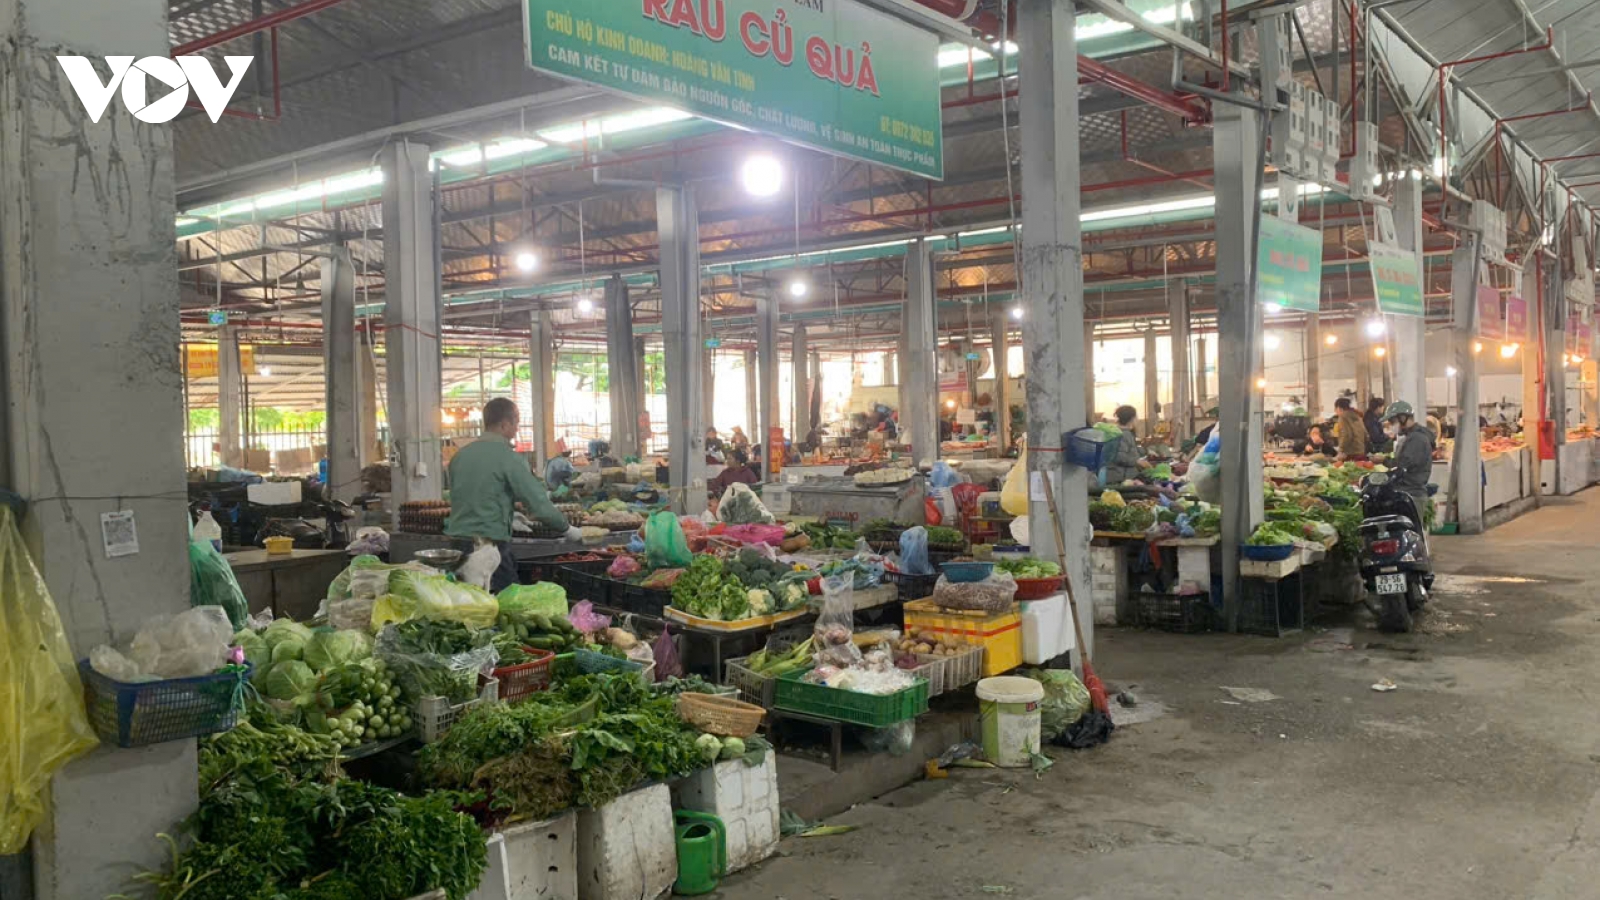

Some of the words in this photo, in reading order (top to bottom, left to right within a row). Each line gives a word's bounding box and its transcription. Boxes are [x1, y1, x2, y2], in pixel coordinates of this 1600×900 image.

[546, 10, 573, 36] CHỦ
[576, 18, 593, 46] HỘ
[596, 25, 626, 52] KINH
[548, 43, 580, 68] CAM
[584, 52, 608, 76] KẾT
[738, 8, 794, 67] CỦ
[805, 35, 881, 98] QUẢ
